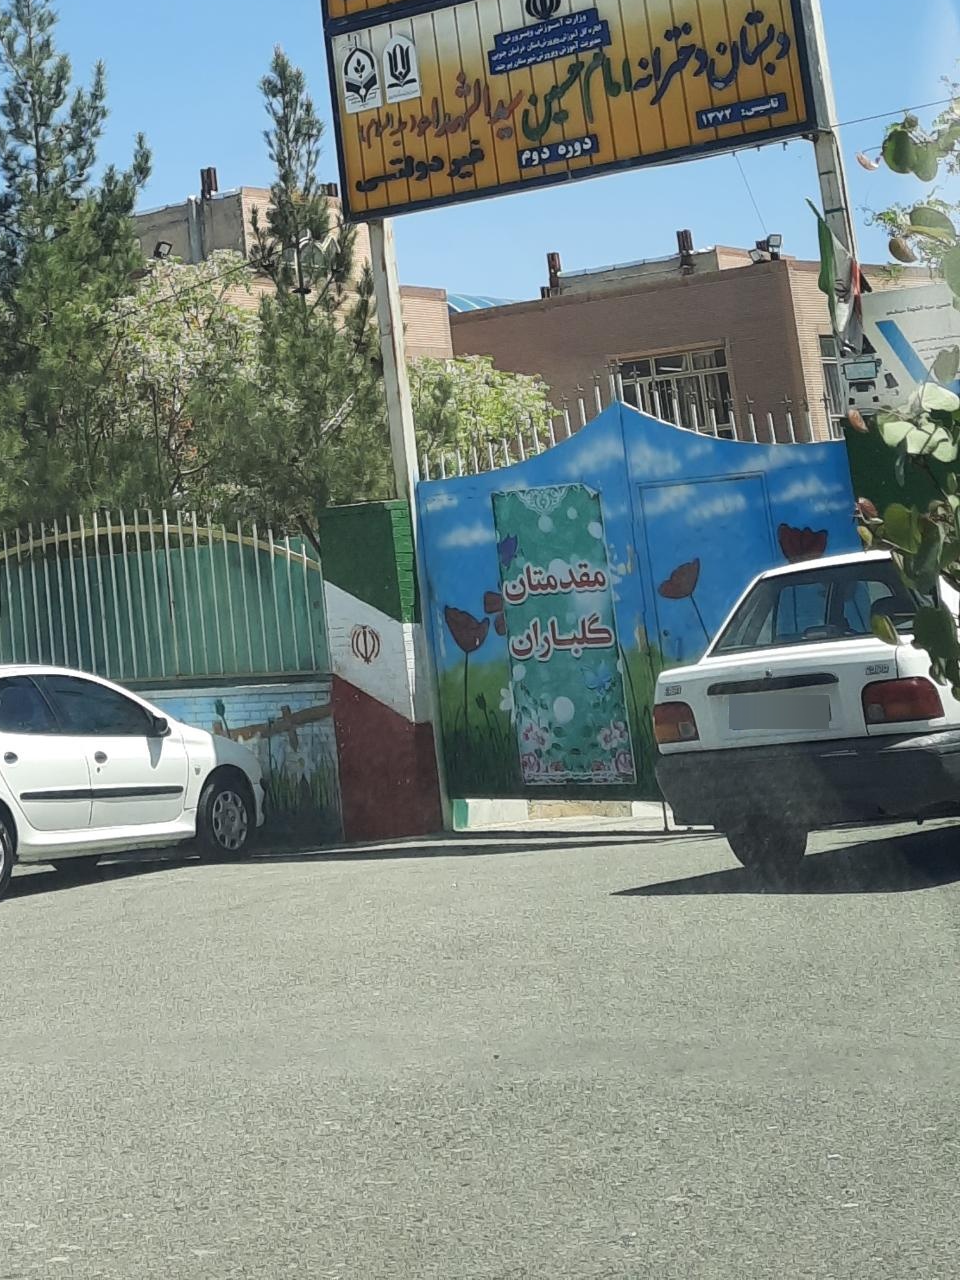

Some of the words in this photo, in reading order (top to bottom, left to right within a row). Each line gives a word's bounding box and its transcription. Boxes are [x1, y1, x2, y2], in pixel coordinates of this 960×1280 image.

[534, 18, 564, 35] آموزش
[565, 14, 587, 25] وزارت
[633, 22, 708, 106] دخترانه
[707, 10, 790, 90] دبستان
[522, 60, 585, 142] حسین
[583, 51, 632, 124] امام
[521, 145, 550, 166] دوم
[557, 136, 592, 158] دوره
[355, 155, 445, 193] دولتی
[504, 562, 607, 603] مقدمتان
[511, 613, 613, 659] گلباران
